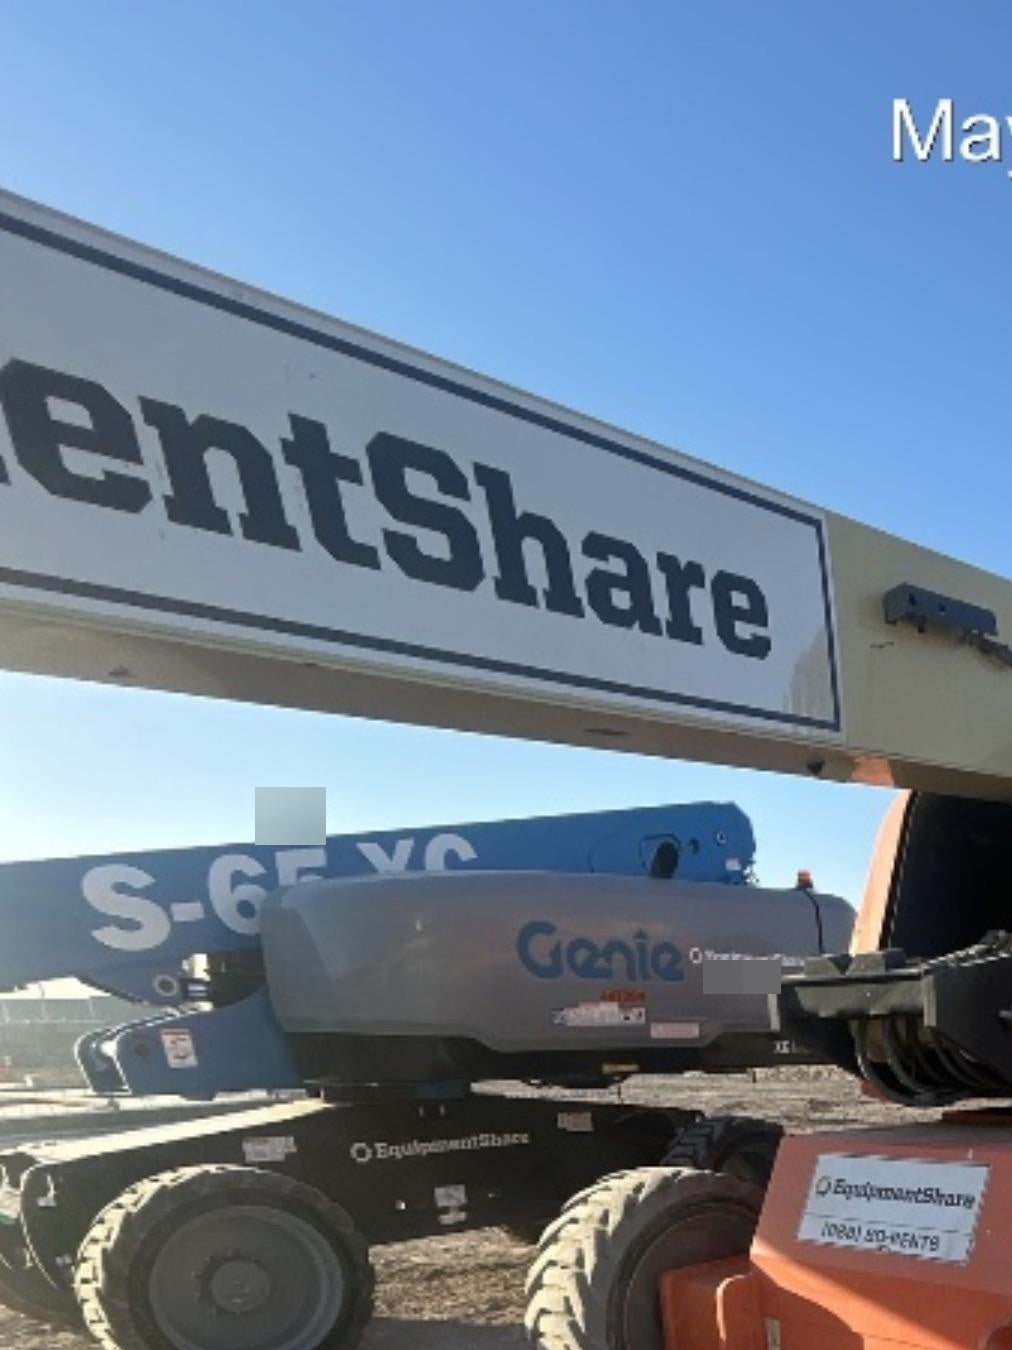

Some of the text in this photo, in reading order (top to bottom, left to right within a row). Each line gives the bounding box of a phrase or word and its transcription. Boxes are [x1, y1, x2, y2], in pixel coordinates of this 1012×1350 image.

[0, 358, 773, 661] entShare
[516, 920, 685, 982] Genie
[833, 1178, 976, 1210] EquipmentShare
